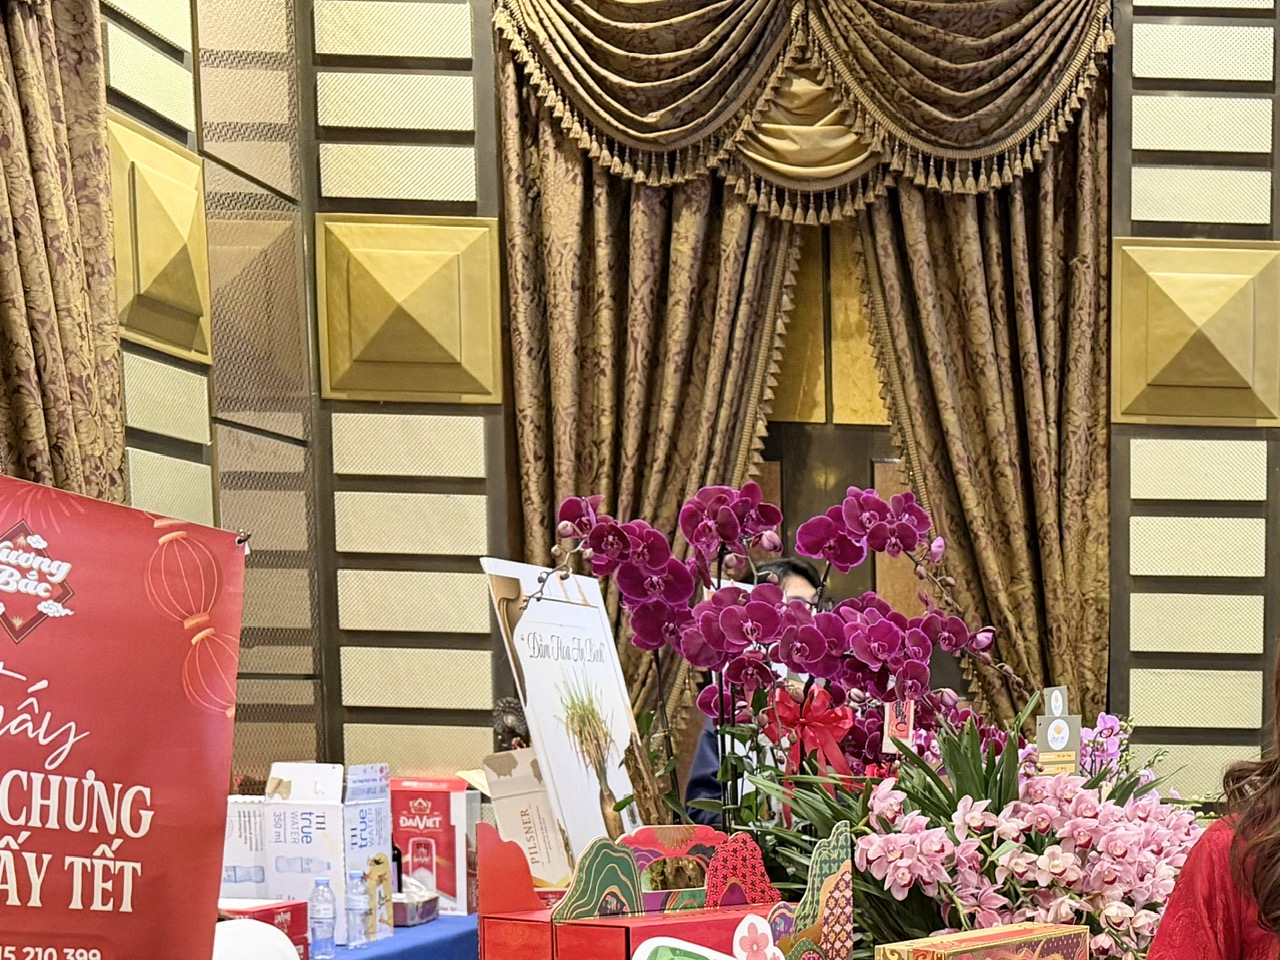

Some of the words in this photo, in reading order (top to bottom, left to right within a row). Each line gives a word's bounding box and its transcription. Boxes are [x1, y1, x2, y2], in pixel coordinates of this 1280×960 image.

[0, 661, 90, 771] ấy
[0, 769, 155, 839] CHƯNG
[273, 812, 283, 830] 350
[290, 810, 300, 845] WATER
[300, 811, 314, 845] true
[358, 808, 368, 849] true
[520, 808, 540, 865] PILSNER
[64, 838, 142, 912] TẾT
